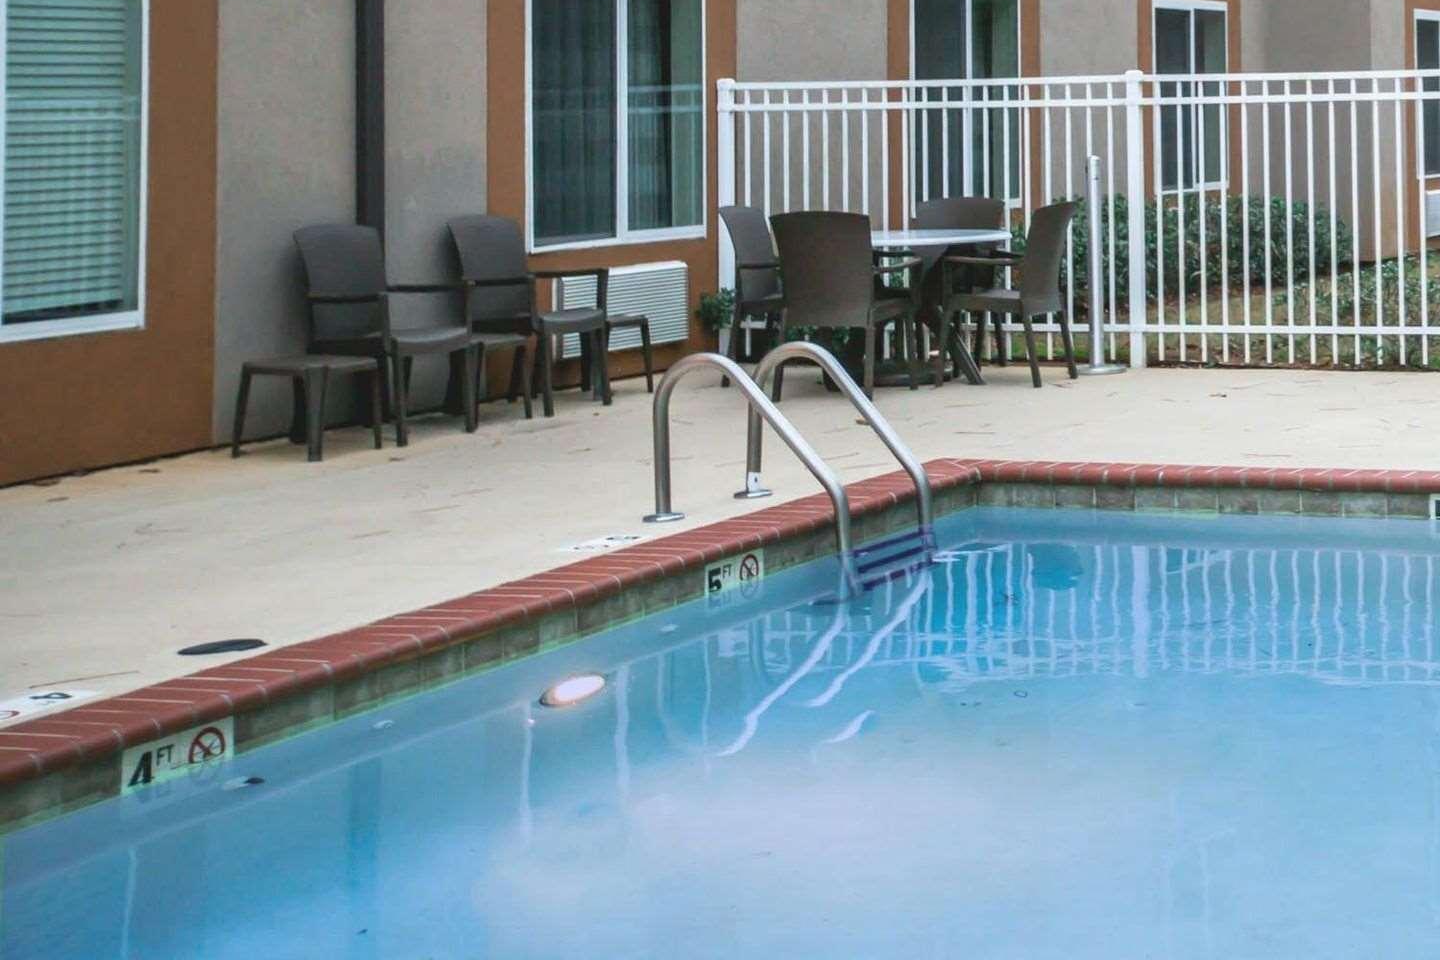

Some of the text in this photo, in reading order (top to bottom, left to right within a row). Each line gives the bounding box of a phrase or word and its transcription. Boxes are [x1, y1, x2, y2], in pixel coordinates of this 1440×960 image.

[708, 563, 732, 592] 5 FT
[127, 743, 175, 787] 4 FT
